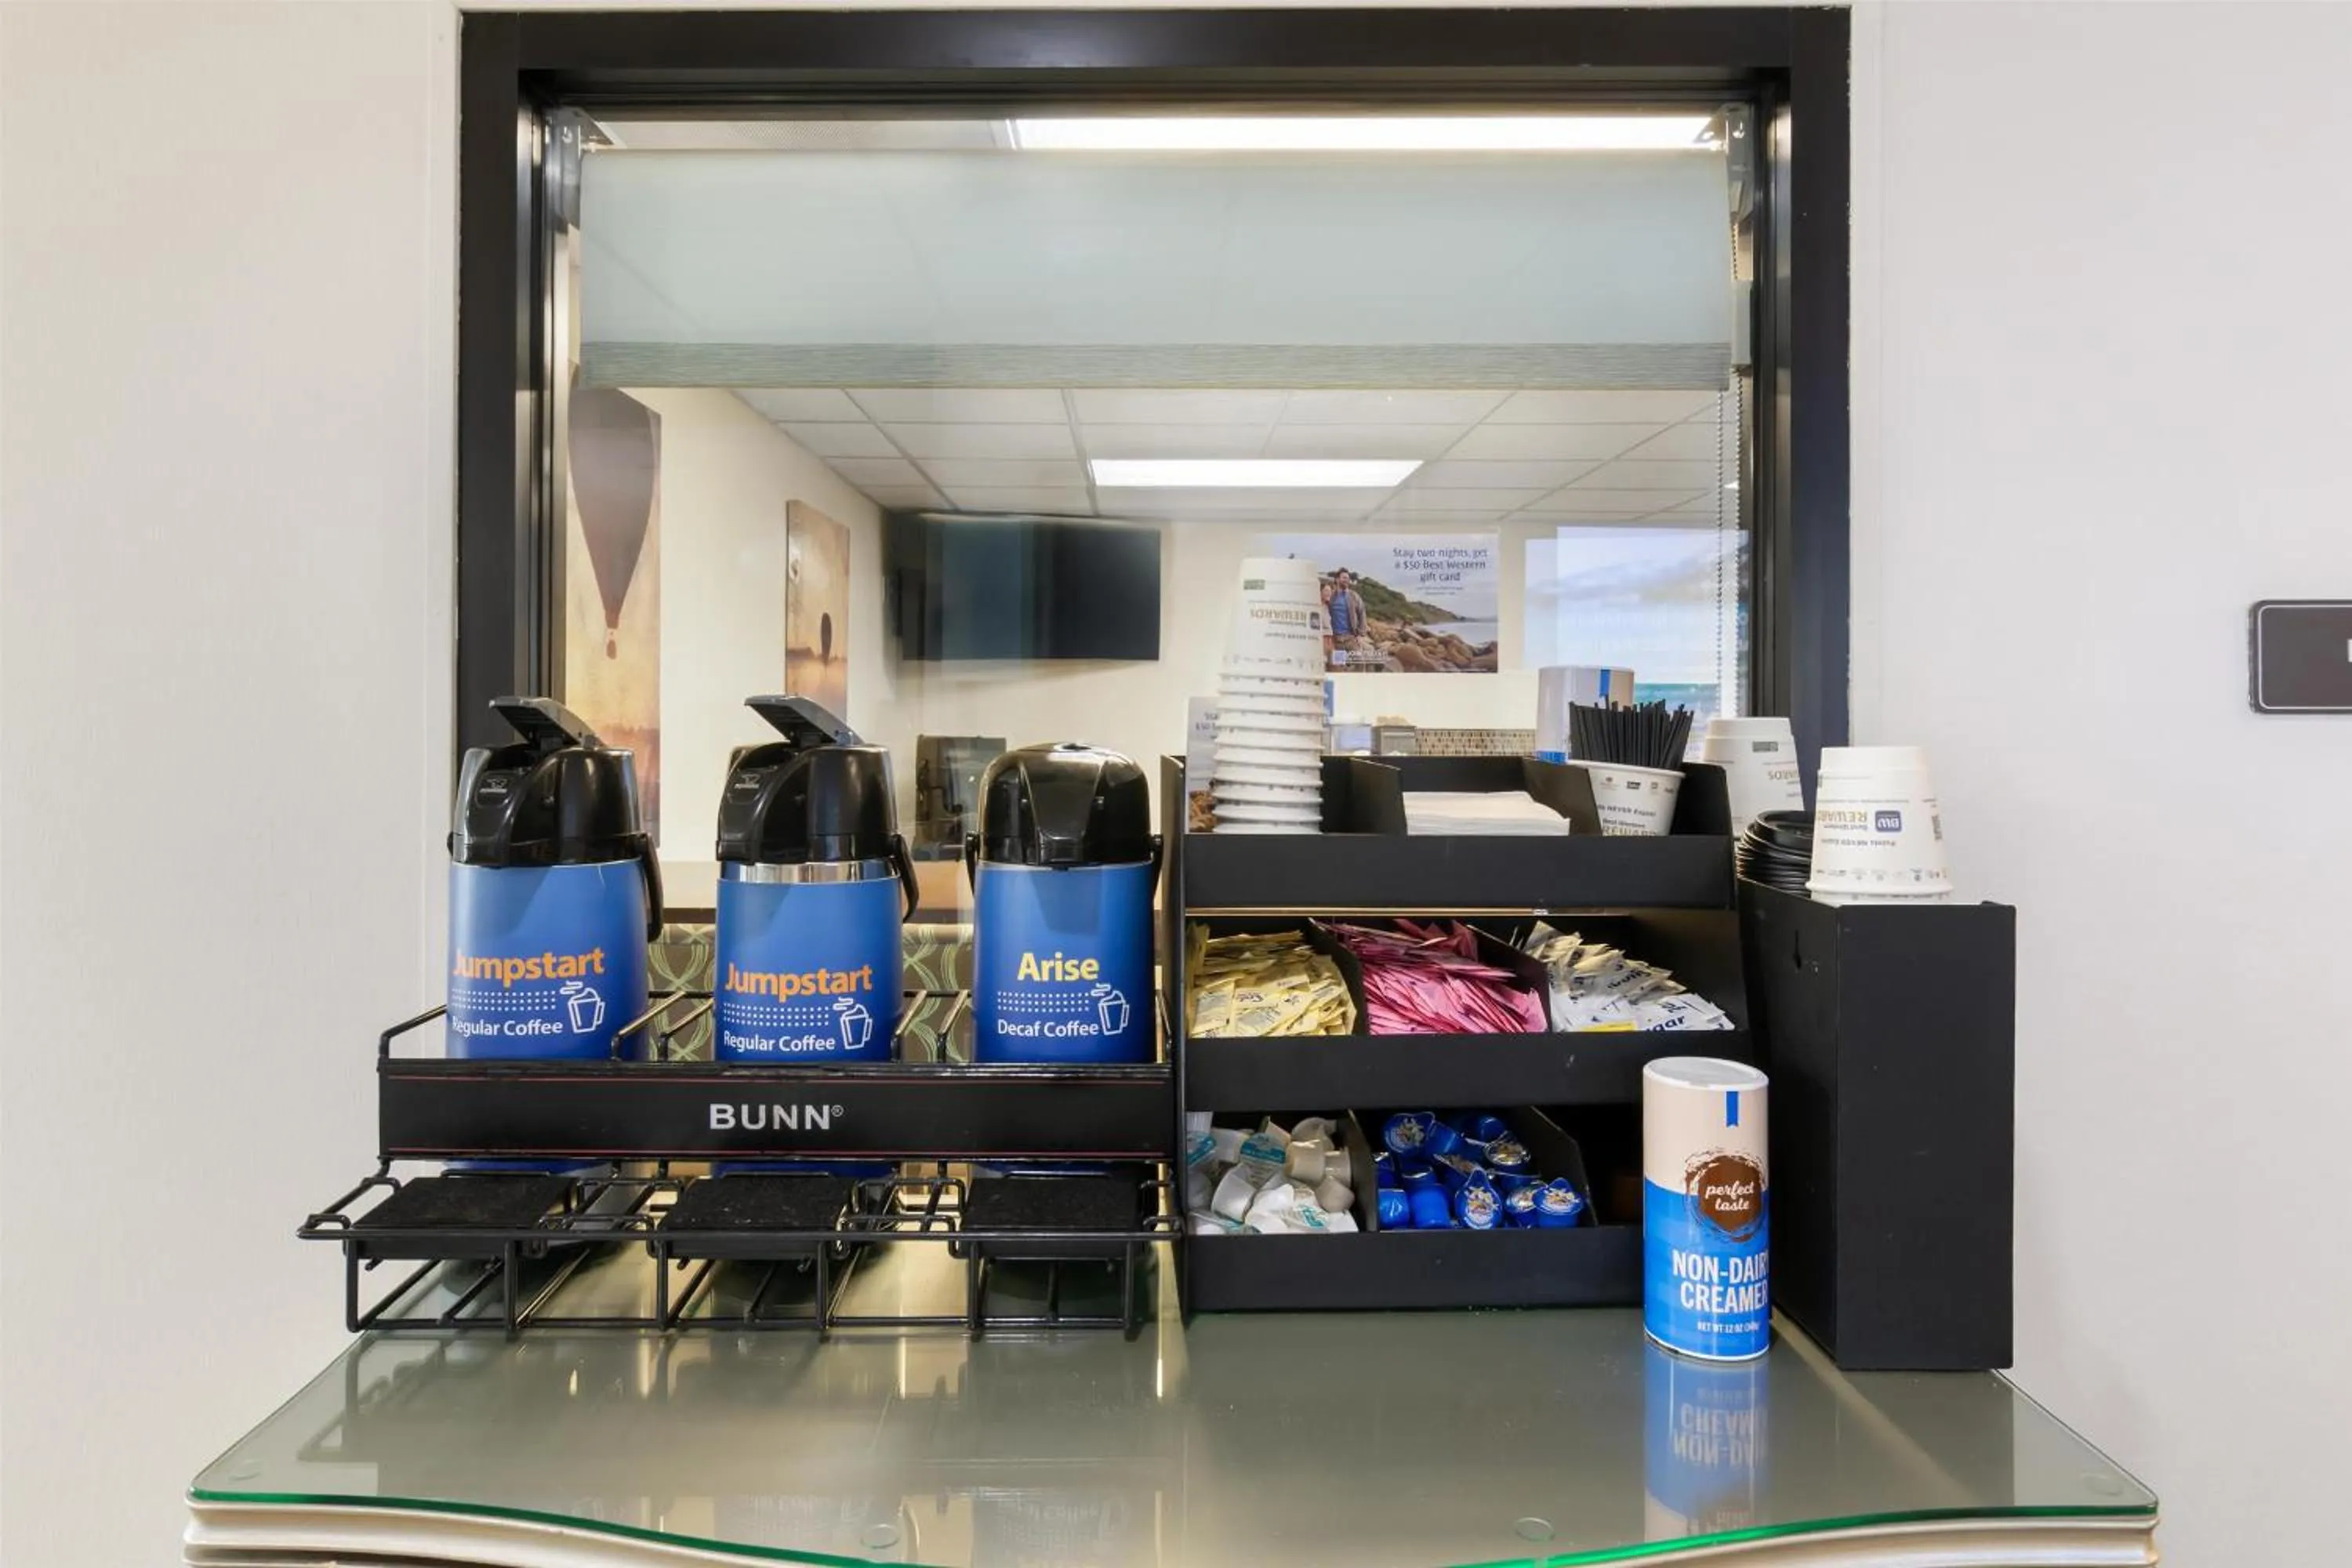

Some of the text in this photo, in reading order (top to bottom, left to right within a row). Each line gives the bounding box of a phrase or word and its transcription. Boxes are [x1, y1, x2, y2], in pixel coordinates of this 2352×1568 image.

[1393, 547, 1414, 558] Stay
[1417, 549, 1435, 557] two
[1473, 549, 1487, 558] get
[1403, 560, 1421, 569] $50
[1424, 560, 1443, 569] Best
[1446, 560, 1486, 569] Western
[1420, 572, 1461, 583] gift card
[452, 946, 604, 988] Jumpstart
[1017, 951, 1100, 982] Arise
[724, 962, 873, 1004] Jumpstart
[452, 1016, 563, 1037] Regular Coffee
[997, 1018, 1098, 1038] Decaf Coffee
[724, 1030, 835, 1053] Regular Coffee
[1705, 1181, 1755, 1200] perfect
[1715, 1197, 1749, 1211] taste
[1680, 1279, 1768, 1313] CREAMER
